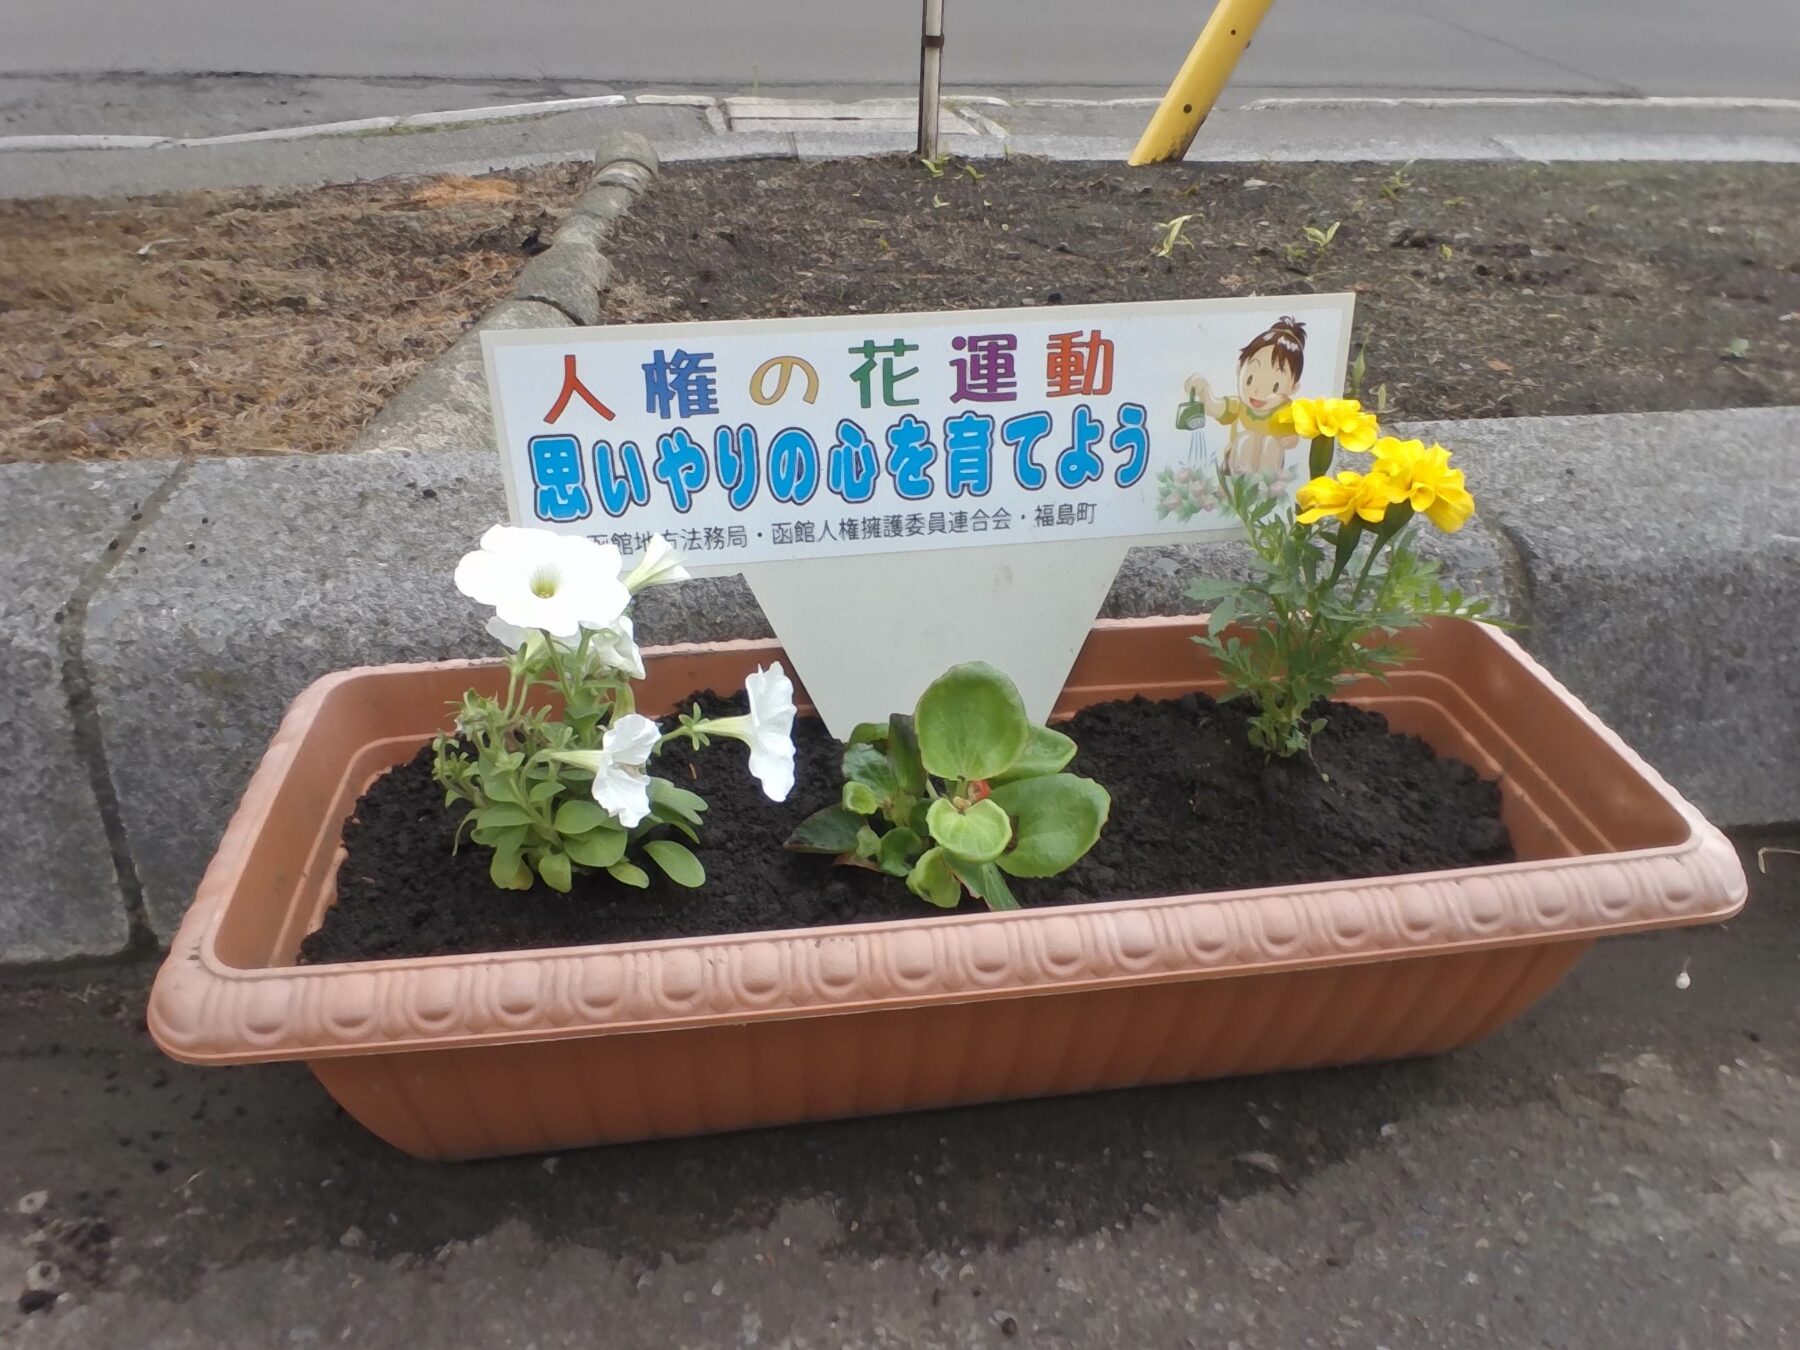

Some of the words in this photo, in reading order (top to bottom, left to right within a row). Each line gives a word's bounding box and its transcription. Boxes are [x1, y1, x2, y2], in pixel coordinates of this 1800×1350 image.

[543, 330, 1114, 424] 人権の花運動
[528, 402, 1149, 522] 思いやりの心を育てよう
